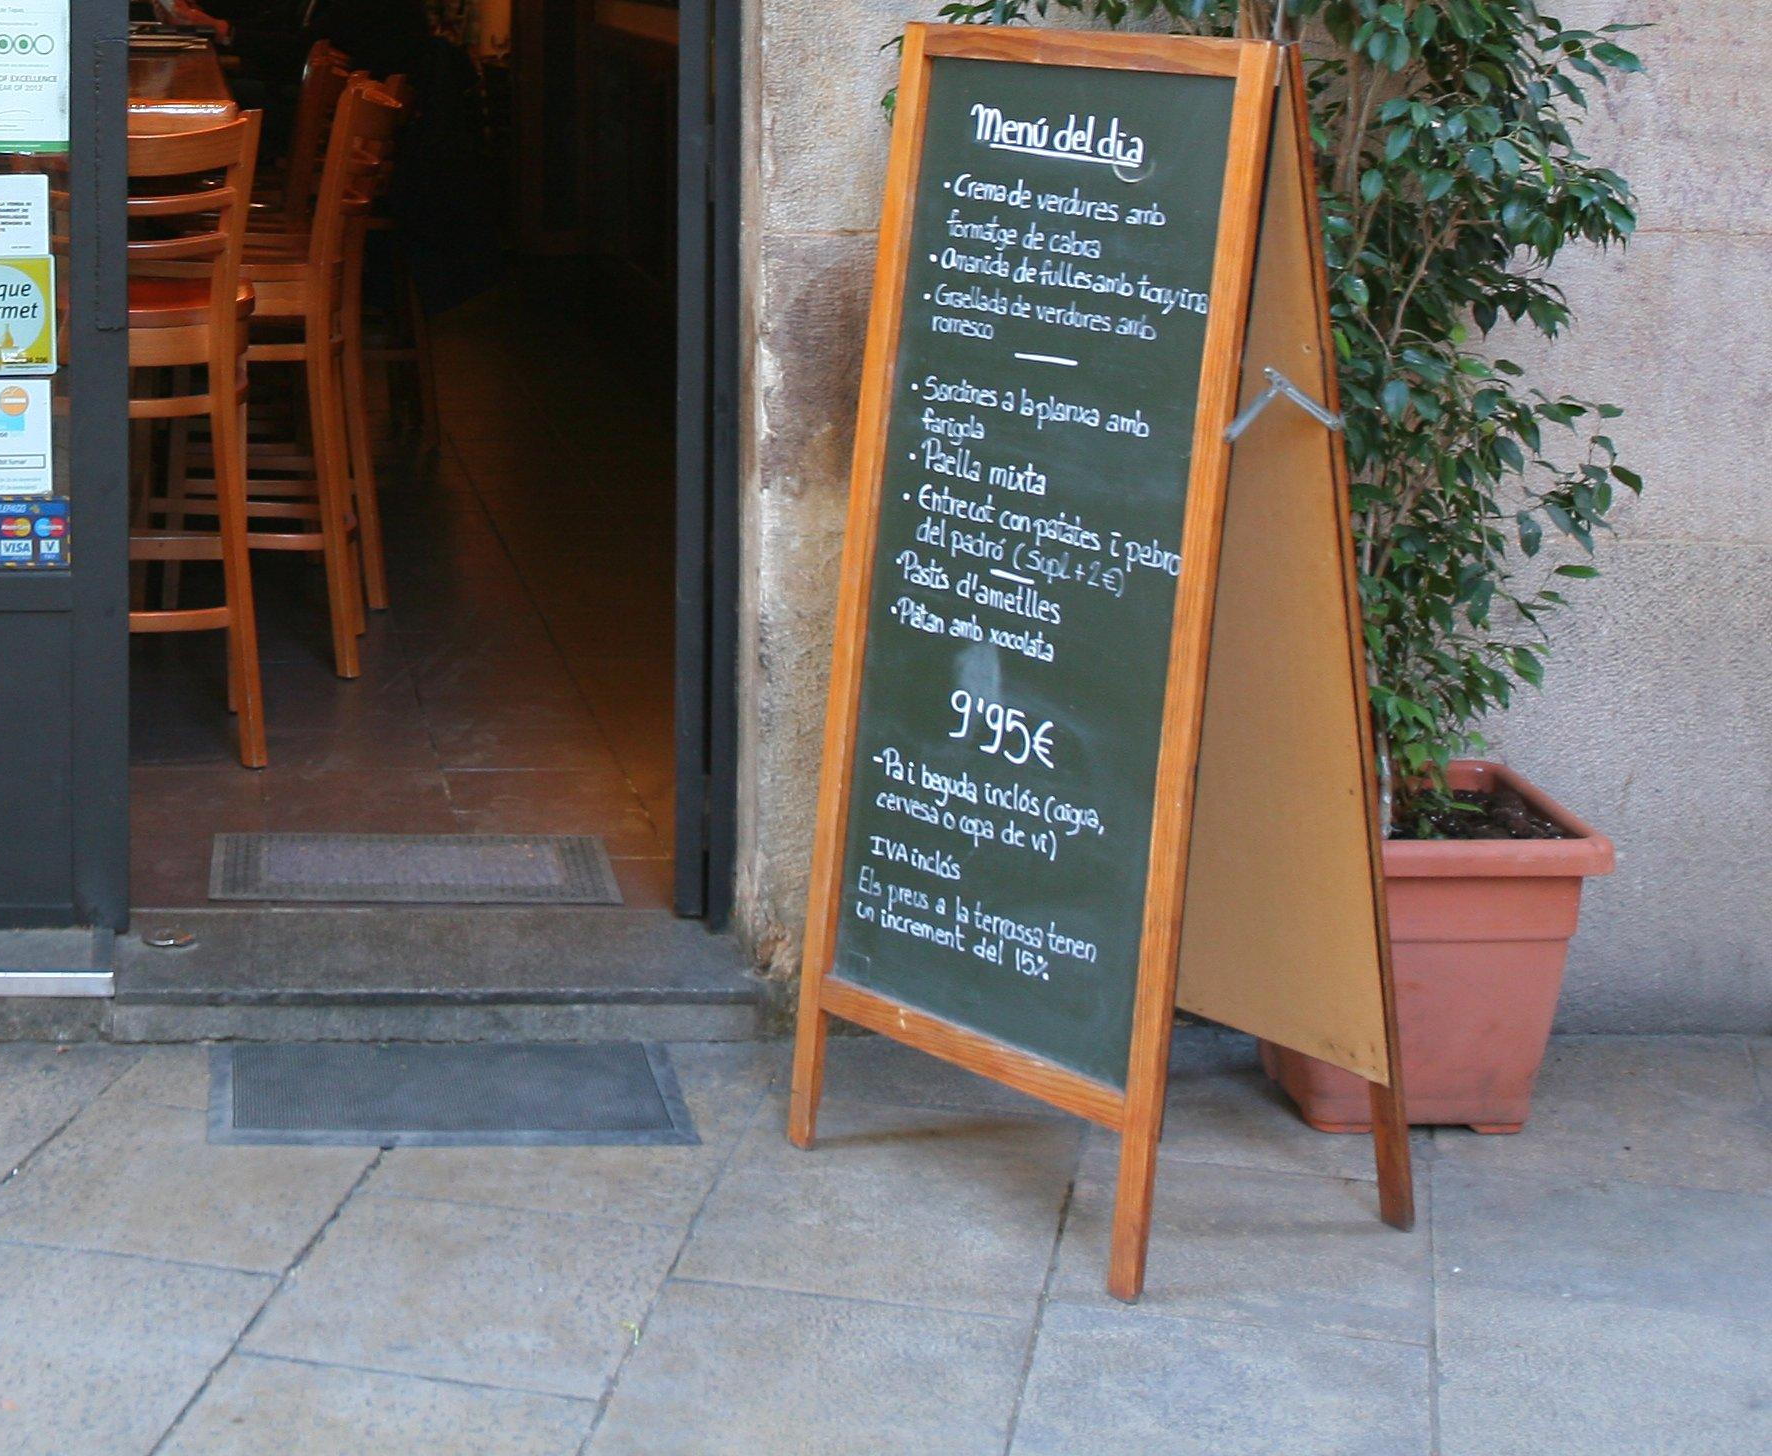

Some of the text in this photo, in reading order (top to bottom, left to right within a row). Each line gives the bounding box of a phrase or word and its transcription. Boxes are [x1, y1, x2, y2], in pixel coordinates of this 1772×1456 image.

[969, 104, 1144, 164] Menú del dia
[1007, 179, 1032, 208] de
[1036, 188, 1119, 221] verdures
[1124, 203, 1166, 225] amb
[1021, 222, 1044, 250] de
[1048, 231, 1101, 258] cabra
[1012, 257, 1037, 283] de
[1091, 272, 1134, 296] amb
[1009, 295, 1031, 318] de
[1035, 301, 1112, 332] verdures
[1036, 396, 1100, 430] planxa
[1104, 410, 1150, 437] amb
[920, 438, 1046, 495] Paella mixta
[4, 543, 31, 552] VISA
[915, 516, 945, 547] del
[1032, 512, 1101, 550] patates
[948, 614, 1054, 662] amb xocolata
[948, 690, 1054, 769] 9'95€
[921, 764, 978, 807] beguda
[875, 792, 941, 824] cervesa
[958, 817, 994, 847] copa
[1000, 820, 1025, 847] de
[869, 836, 908, 862] IVA
[858, 866, 881, 896] Els
[887, 884, 929, 911] preus
[955, 896, 969, 923] la
[1046, 922, 1097, 963] tenen
[880, 903, 1049, 980] increment del 15%
